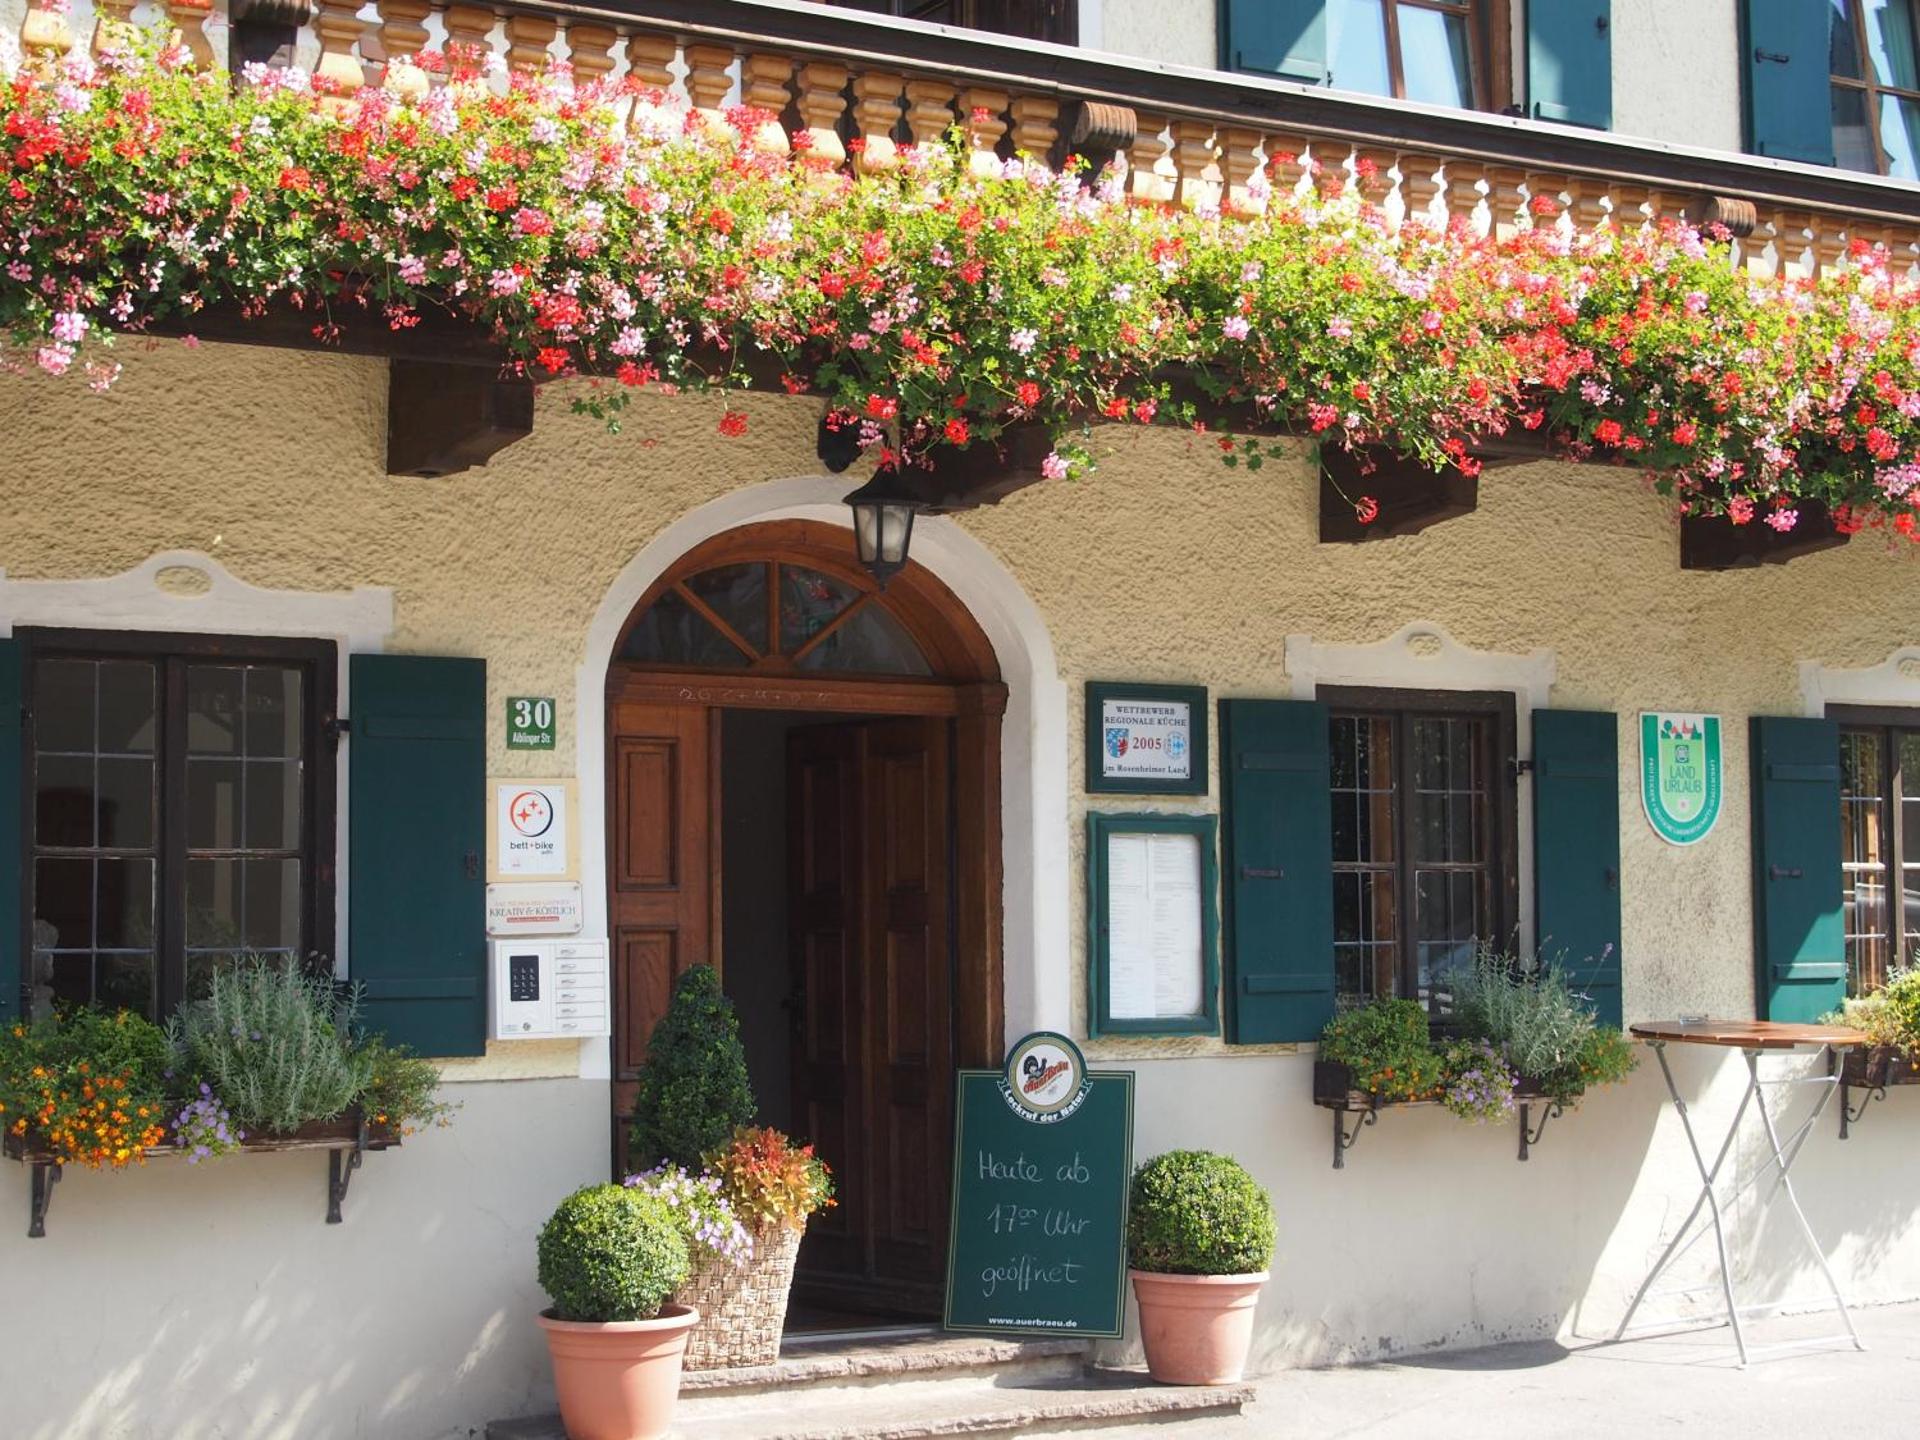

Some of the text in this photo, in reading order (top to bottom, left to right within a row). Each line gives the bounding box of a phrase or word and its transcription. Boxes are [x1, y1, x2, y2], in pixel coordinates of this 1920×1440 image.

[514, 700, 551, 728] 30
[1116, 706, 1175, 715] WETTBEWERB
[1105, 717, 1187, 726] REGIONALE KÜCHE
[1132, 736, 1162, 749] 2005
[1117, 764, 1166, 773] Rosenheimer
[1168, 765, 1187, 774] Land
[1669, 766, 1696, 779] LAND
[1664, 779, 1703, 793] URLAUB
[489, 907, 525, 917] KREATIV
[1004, 1089, 1084, 1122] Lockruf der Natur
[979, 1149, 1090, 1183] Heute ab
[1043, 1207, 1091, 1237] Uhr
[981, 1254, 1085, 1297] geöffnet
[988, 1316, 1078, 1328] www.auerbraeu.de
